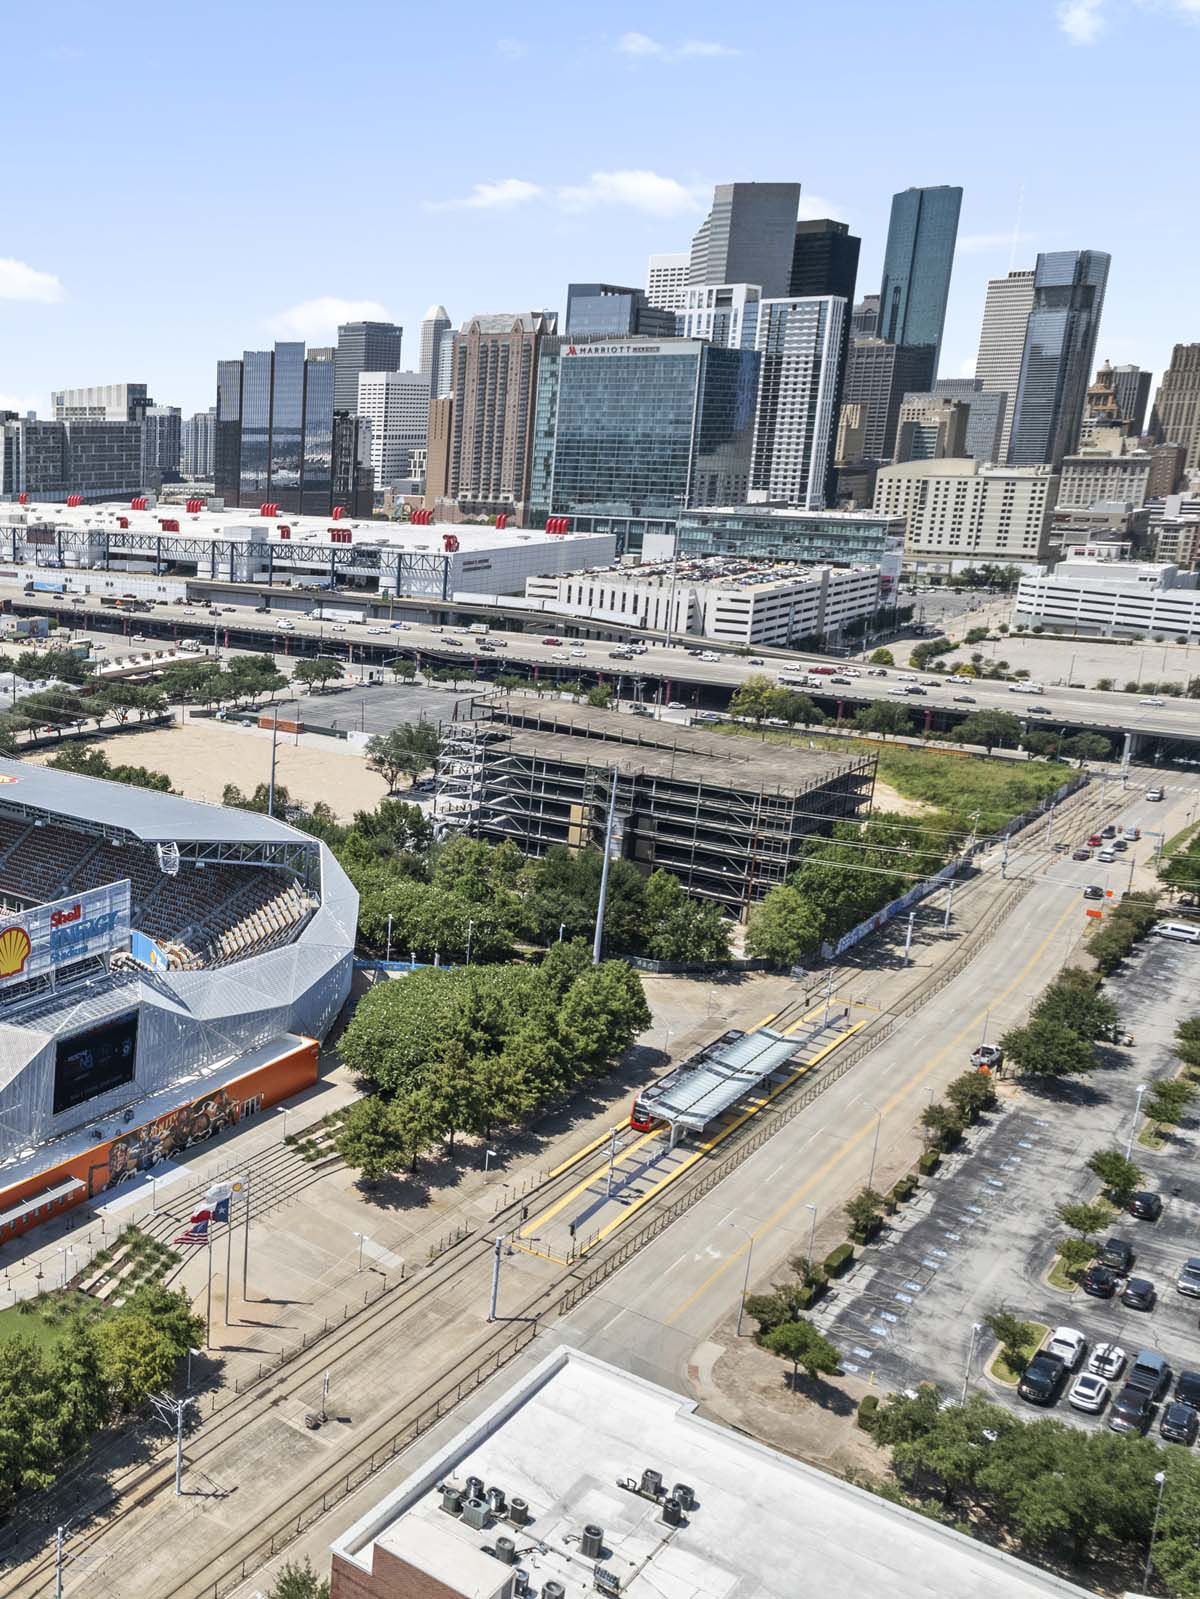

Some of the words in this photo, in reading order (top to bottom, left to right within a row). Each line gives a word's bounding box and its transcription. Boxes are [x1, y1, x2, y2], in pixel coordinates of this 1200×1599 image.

[580, 346, 631, 354] MARRIOTT
[51, 904, 81, 928] Shell
[51, 910, 119, 950] ENERGY
